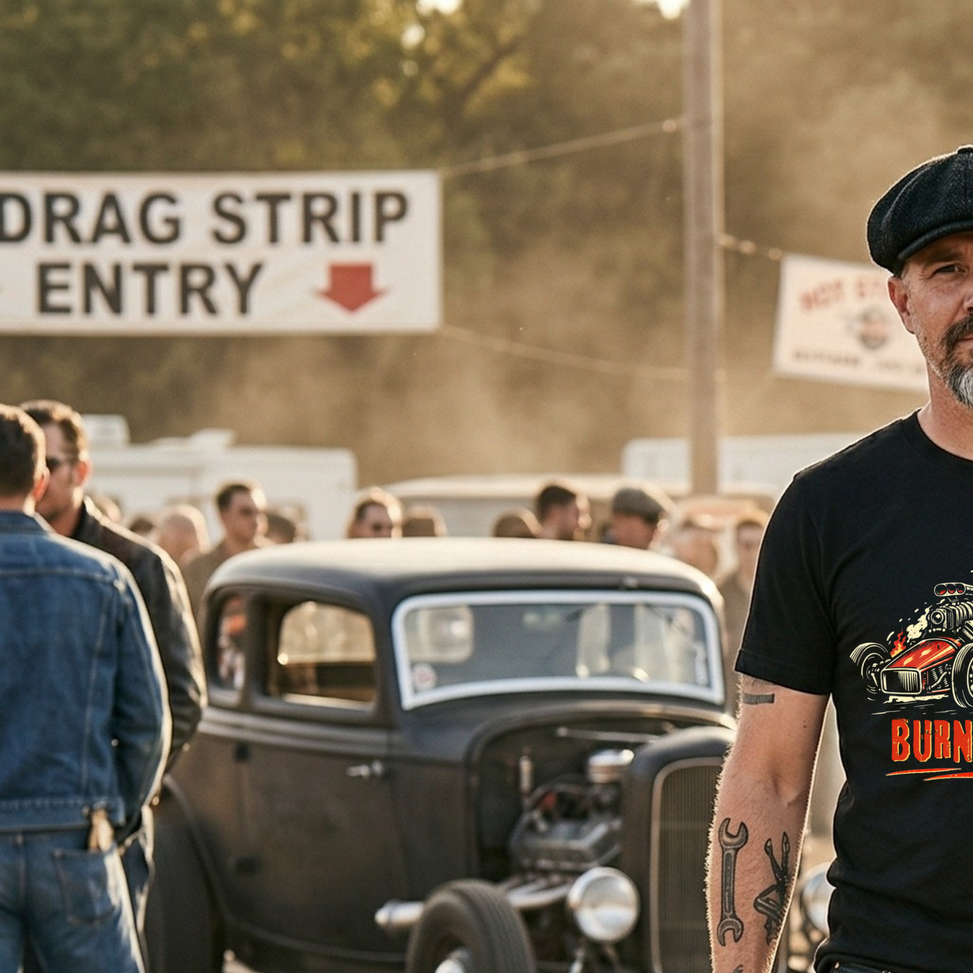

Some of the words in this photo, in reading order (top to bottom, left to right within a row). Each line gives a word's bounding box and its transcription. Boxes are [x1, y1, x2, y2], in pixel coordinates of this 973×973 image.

[0, 191, 181, 244] DRAG
[212, 191, 408, 244] STRIP
[37, 262, 263, 314] ENTRY
